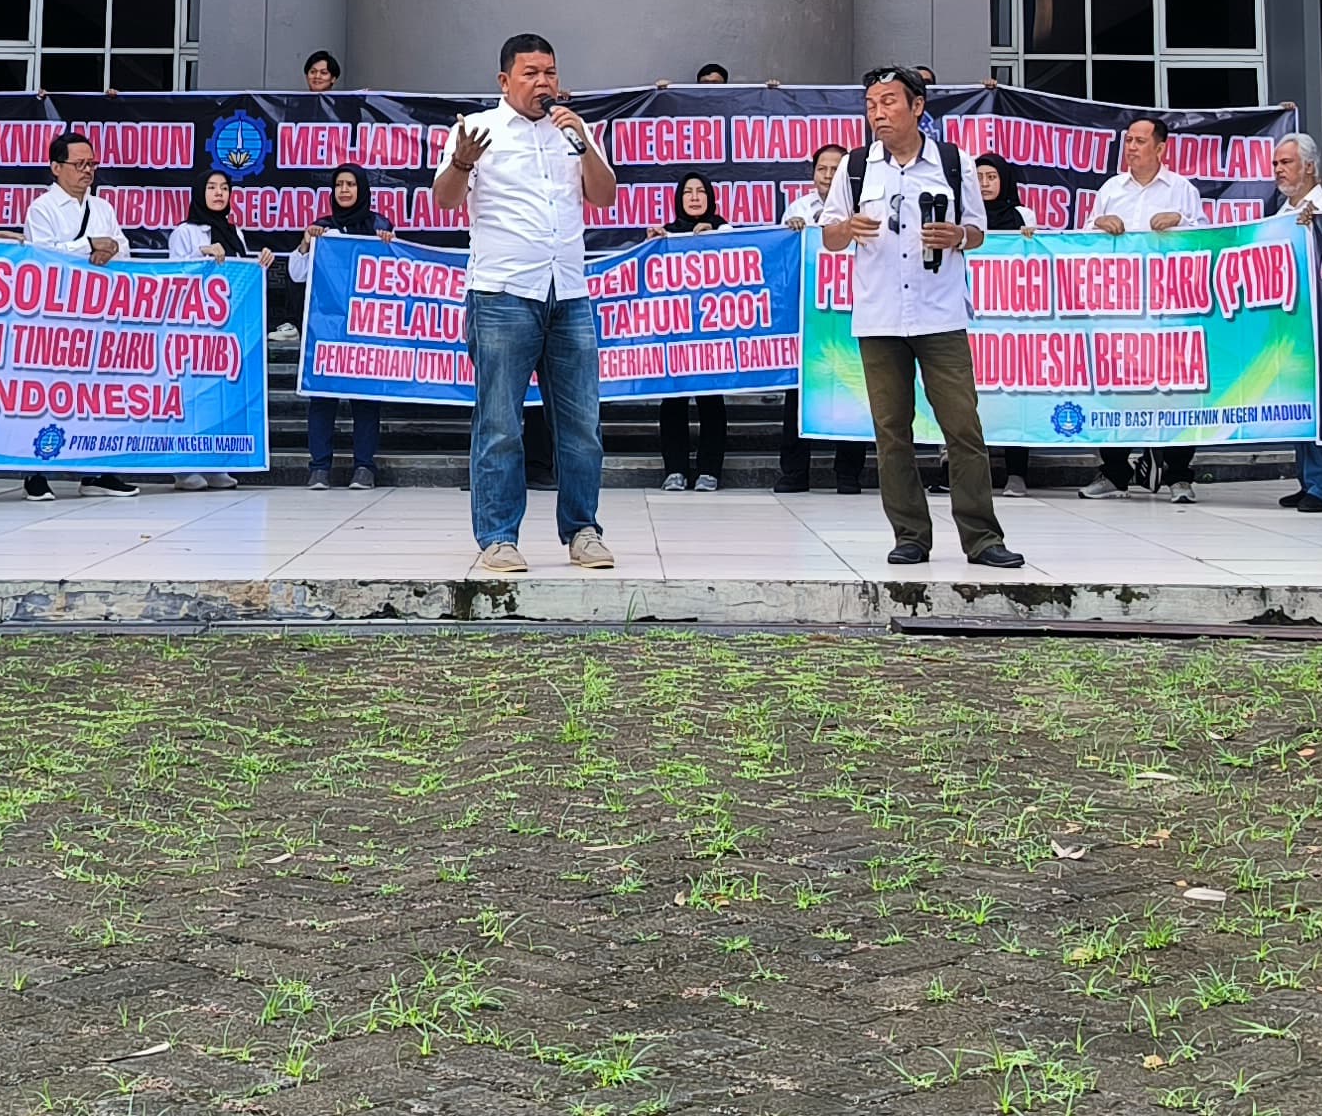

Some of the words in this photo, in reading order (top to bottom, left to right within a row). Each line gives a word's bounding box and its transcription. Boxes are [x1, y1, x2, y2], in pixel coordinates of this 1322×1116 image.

[279, 125, 420, 168] MENJADI
[614, 118, 724, 163] NEGERI
[733, 117, 864, 162] MADIUN
[945, 117, 1114, 173] MENUNTUT
[1121, 132, 1274, 180] ADILAN
[228, 189, 332, 230] SECARA
[357, 257, 466, 299] DESKRE
[645, 249, 763, 289] GUSDUR
[968, 258, 1051, 313] TINGGI
[1056, 257, 1140, 313] NEGERI
[1148, 254, 1211, 312] BARU
[1215, 241, 1297, 315] (PTNB)
[599, 299, 691, 338] TAHUN
[699, 291, 772, 328] 2001
[12, 324, 95, 369] TINGGI
[98, 331, 157, 371] BARU
[163, 334, 242, 378] (PTNB)
[315, 344, 413, 381] PENEGERIAN
[416, 348, 453, 382] UTM
[668, 339, 736, 375] UNTIRTA
[740, 335, 800, 369] BANTEN
[968, 331, 1089, 388] NDONESIA
[1093, 330, 1205, 387] BERDUKA
[1090, 410, 1122, 428] PTNB
[1124, 409, 1154, 428] BAST
[1157, 407, 1220, 427] POLITEKNIK
[1221, 405, 1259, 425] NEGERI
[1260, 403, 1312, 423] MADIUN
[68, 434, 97, 452] PTNB
[98, 435, 124, 452] BAST
[125, 436, 175, 453] POLITEKNIK
[177, 436, 213, 453] NEGERI
[214, 436, 254, 453] MADIUN
